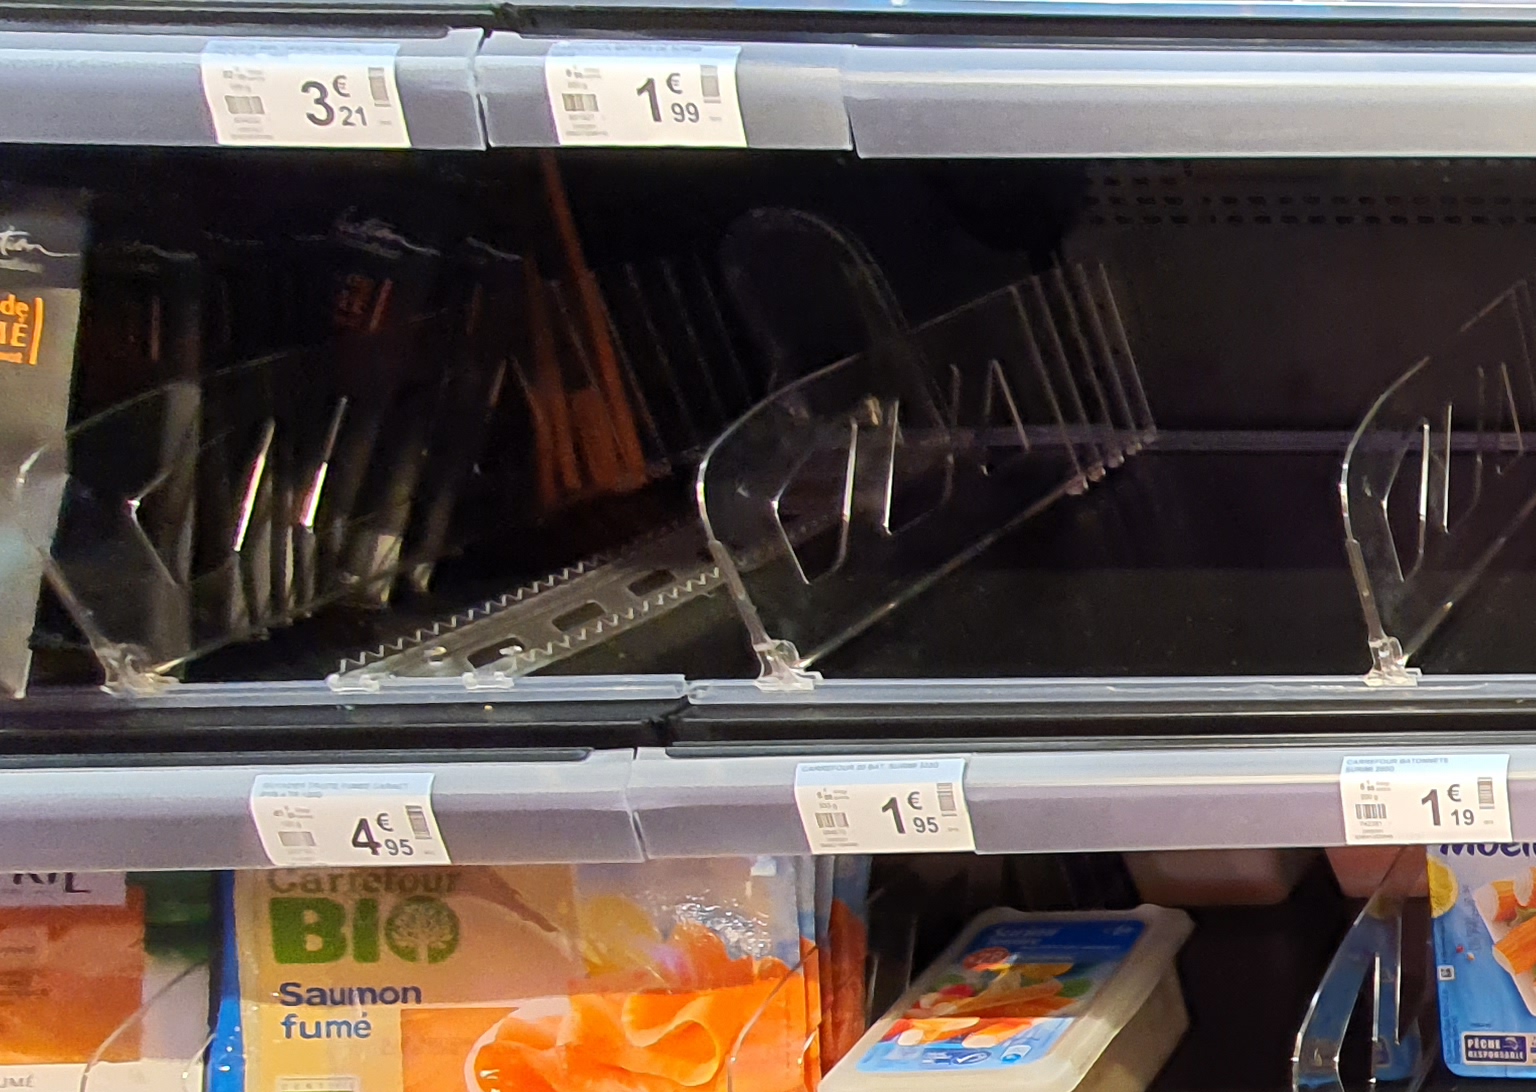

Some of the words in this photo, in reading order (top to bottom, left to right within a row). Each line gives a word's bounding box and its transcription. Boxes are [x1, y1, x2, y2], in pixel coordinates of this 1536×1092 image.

[268, 896, 461, 965] BIO
[279, 982, 422, 1007] Saumon
[280, 1012, 372, 1039] fumé
